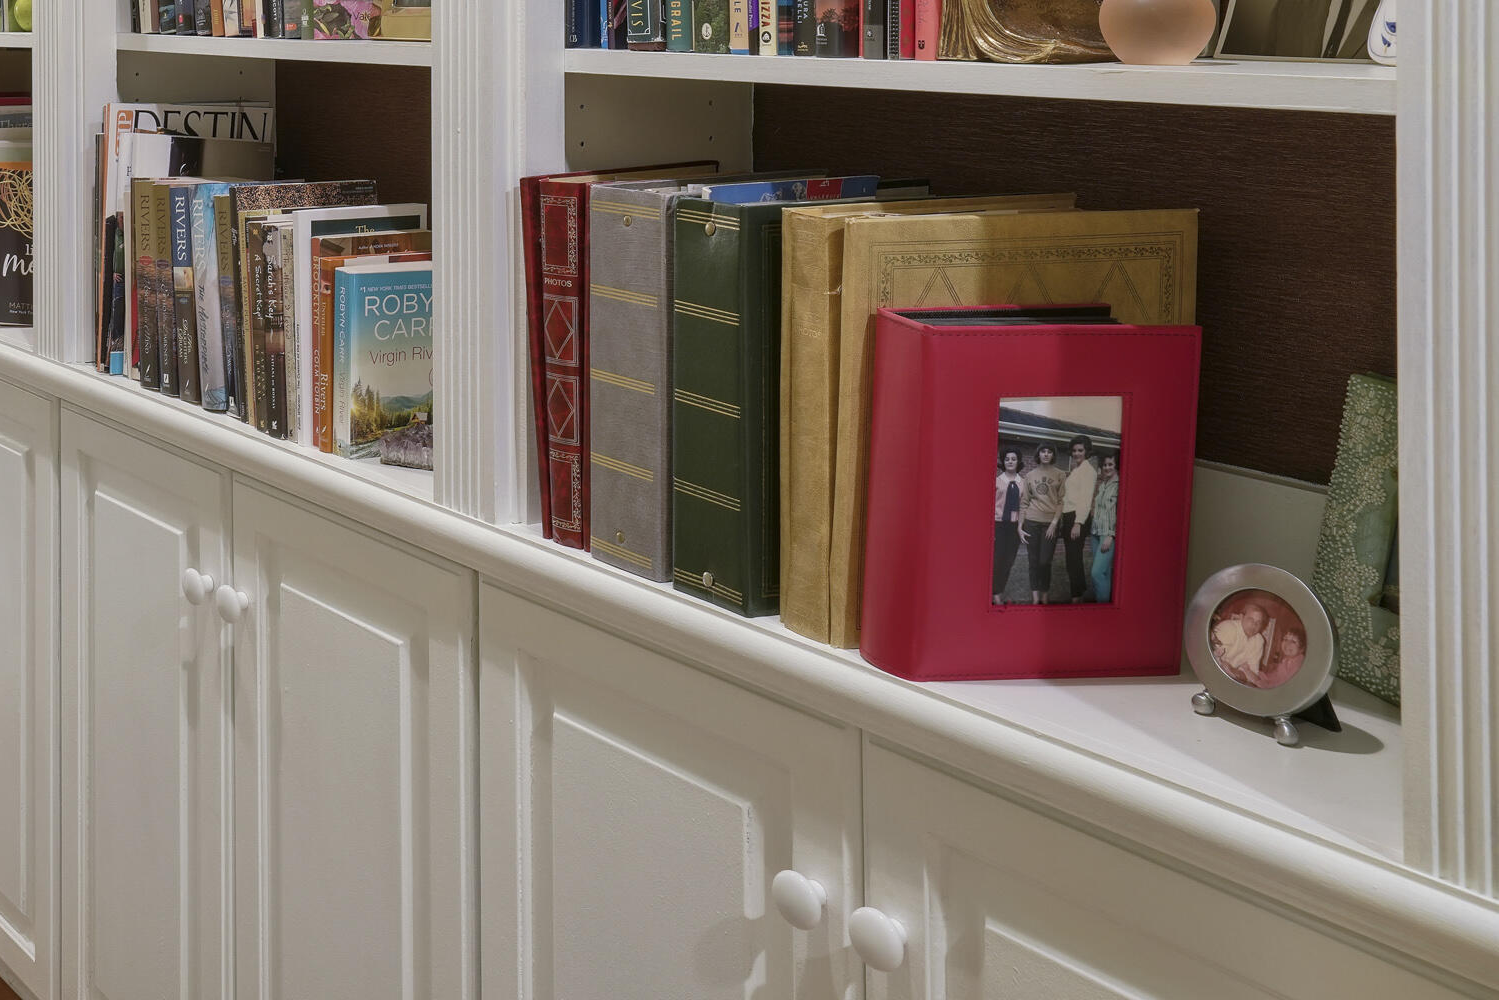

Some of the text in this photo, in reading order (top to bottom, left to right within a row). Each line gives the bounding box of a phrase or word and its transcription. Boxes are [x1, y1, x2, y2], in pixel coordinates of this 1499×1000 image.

[670, 1, 682, 40] GRAIL
[140, 195, 151, 251] RIVERS
[157, 198, 167, 255] RIVERS
[175, 196, 187, 260] RIVERS
[192, 199, 207, 270] RIVERS
[219, 211, 231, 272] RIVERS
[355, 225, 375, 234] The
[255, 265, 264, 297] Secret
[265, 255, 278, 320] Sarah's Key
[312, 255, 320, 326] BROOKLYN
[544, 278, 573, 288] PHOTOS
[253, 299, 264, 321] Kept
[364, 292, 433, 317] ROBY
[198, 305, 209, 375] MASTERPIECE
[338, 331, 346, 363] CARR
[369, 346, 433, 367] Virgin Riv
[320, 373, 329, 411] Rivers
